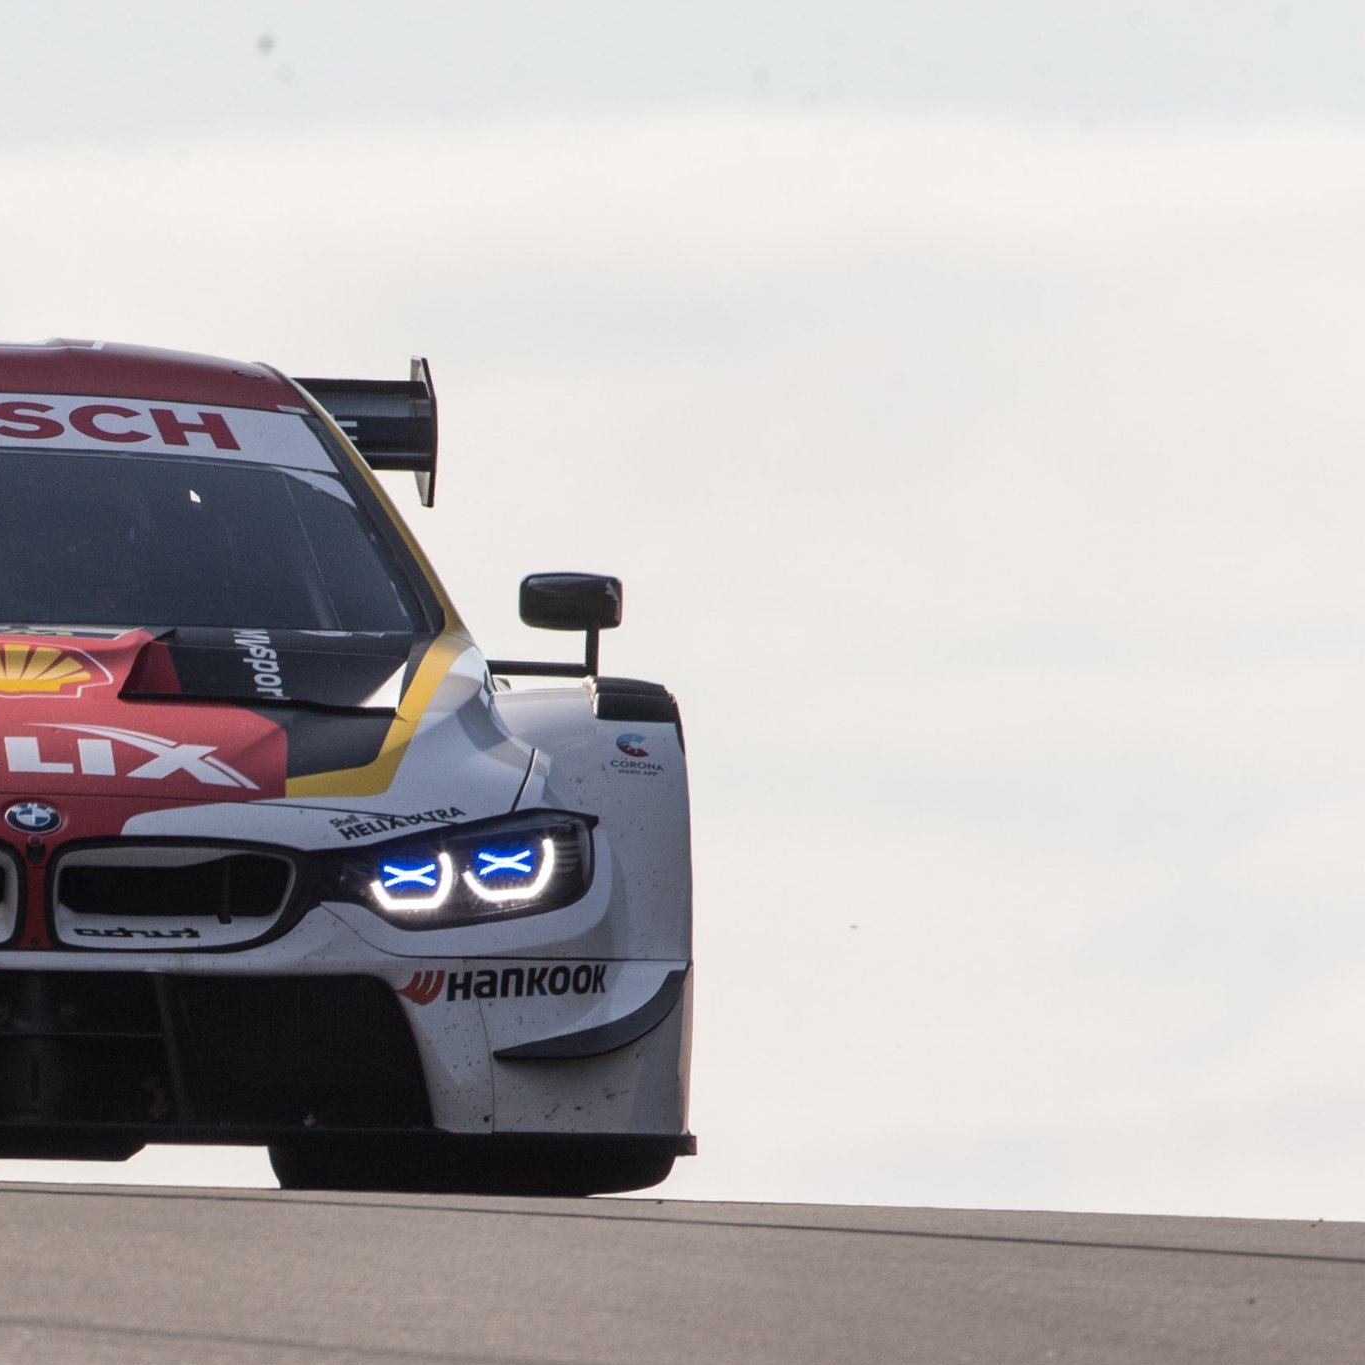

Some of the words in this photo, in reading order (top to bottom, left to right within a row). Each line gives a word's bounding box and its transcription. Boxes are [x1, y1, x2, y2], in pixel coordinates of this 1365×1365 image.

[610, 760, 665, 772] CORONA
[329, 814, 361, 828] Shell
[337, 815, 405, 841] HELIX
[405, 806, 467, 825] ULTRA
